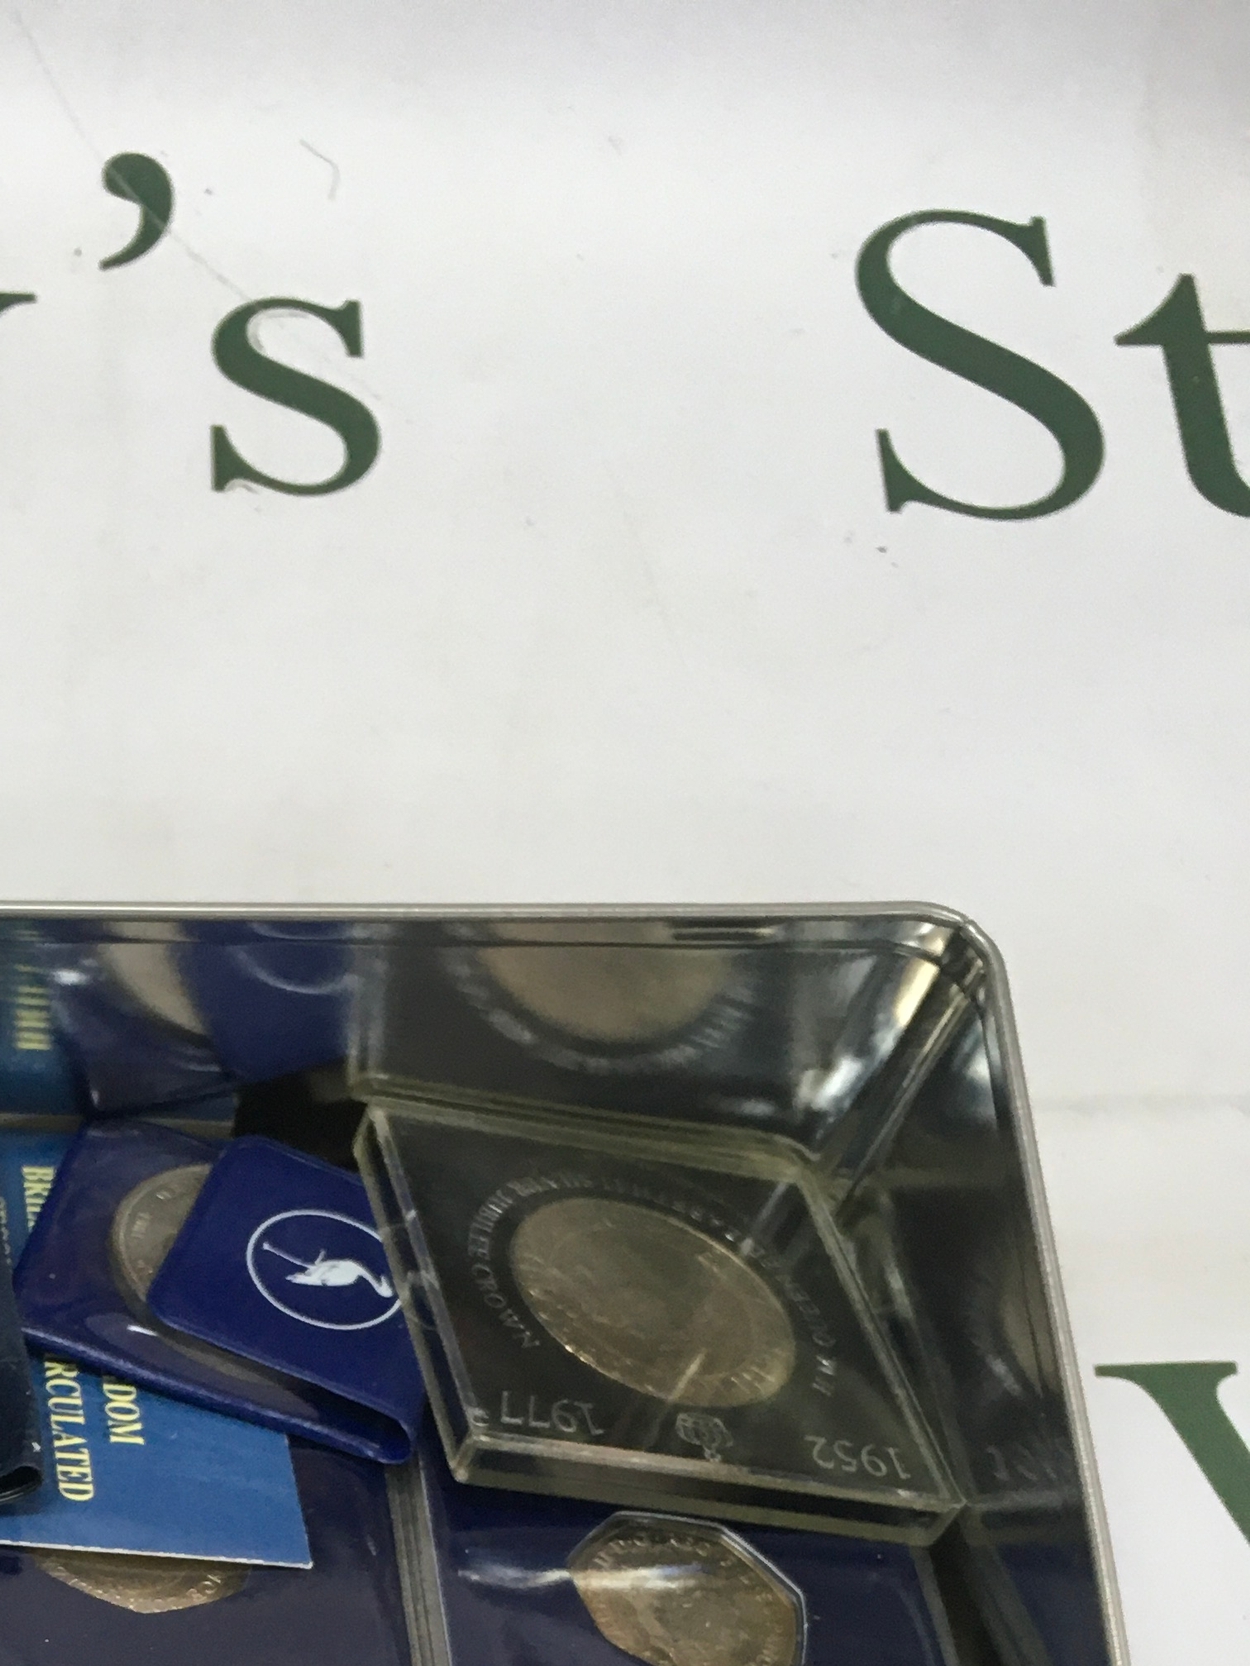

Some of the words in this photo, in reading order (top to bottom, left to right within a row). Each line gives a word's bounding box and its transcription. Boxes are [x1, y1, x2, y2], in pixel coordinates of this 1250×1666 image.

[855, 208, 1250, 520] St
[43, 1361, 96, 1502] RCULATED
[100, 1380, 145, 1447] DOM
[499, 1388, 605, 1437] 1977
[802, 1433, 913, 1481] 1952
